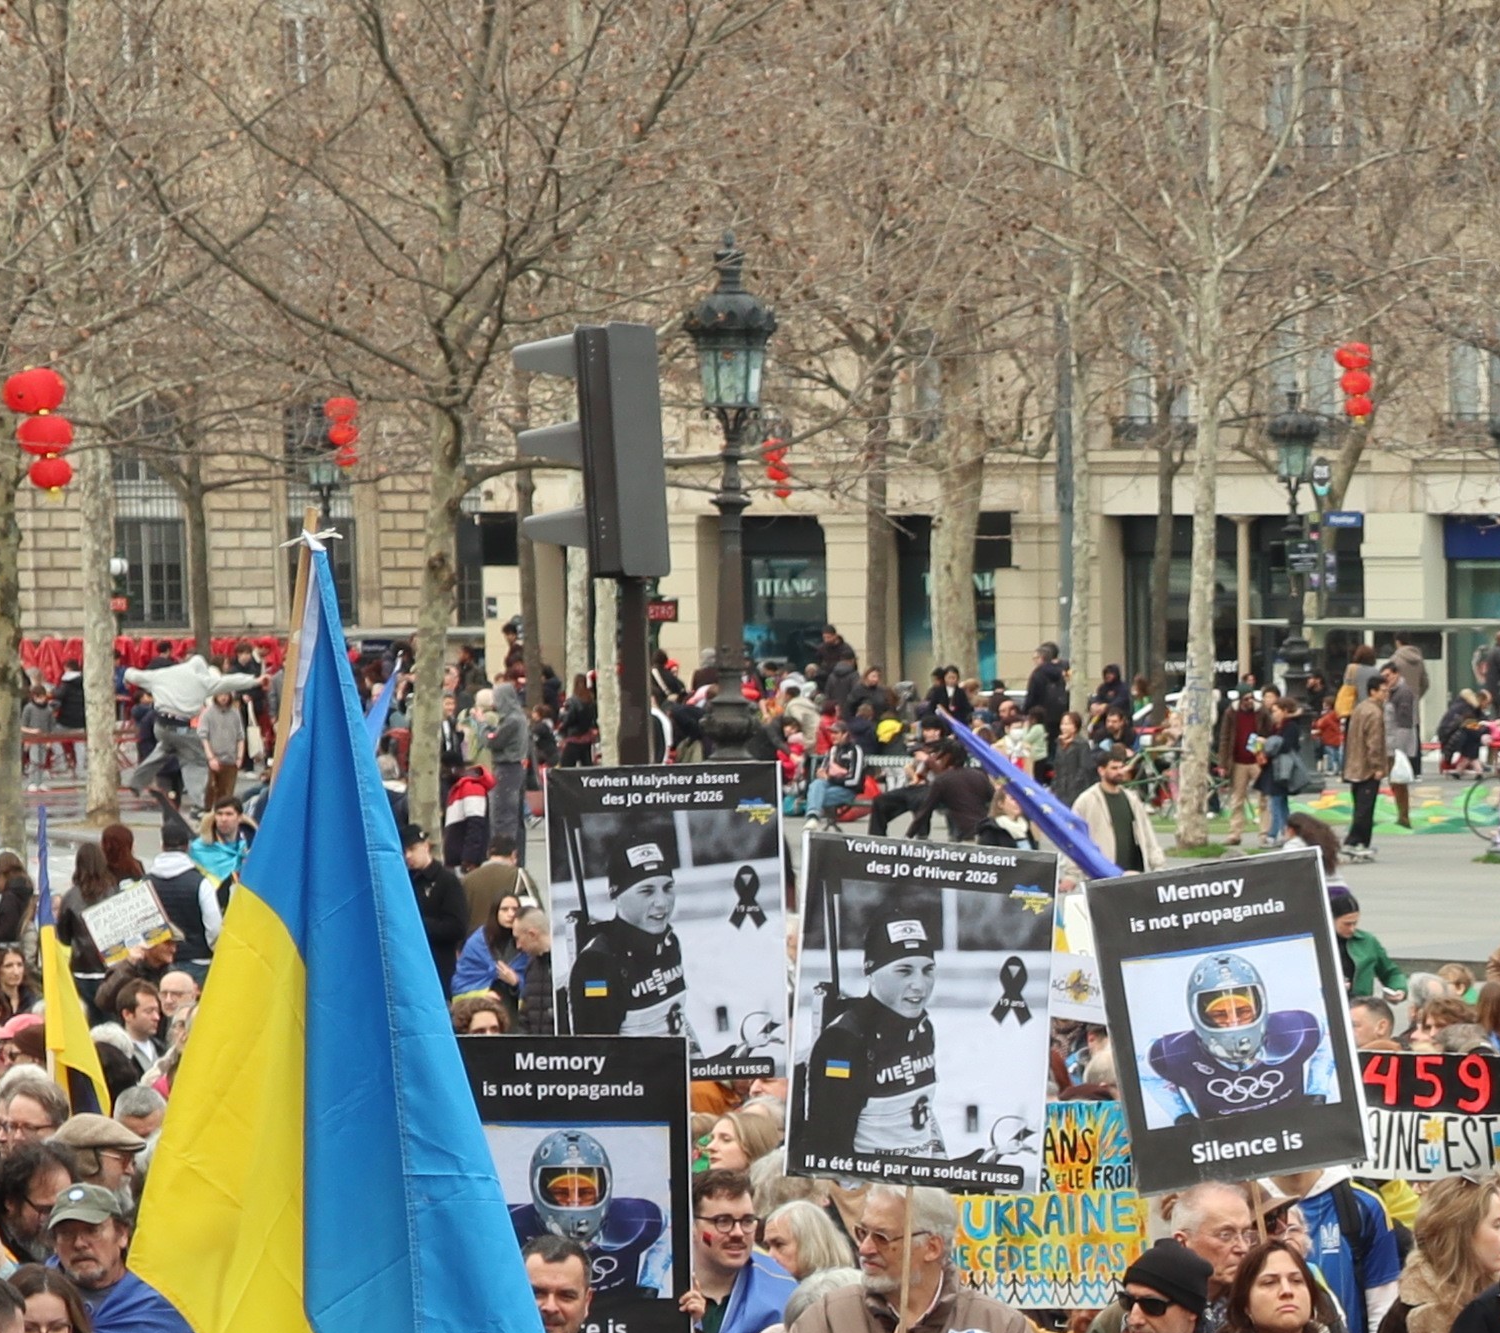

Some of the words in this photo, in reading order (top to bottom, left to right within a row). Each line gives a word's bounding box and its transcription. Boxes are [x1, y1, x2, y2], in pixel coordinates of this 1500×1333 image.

[756, 578, 820, 598] TITANIC
[580, 774, 629, 789] Yevhen
[631, 773, 693, 789] Malyshev
[695, 771, 740, 785] absent
[601, 793, 625, 807] des
[626, 792, 643, 808] JO
[693, 789, 724, 803] 2026
[845, 839, 898, 857] Yevhen
[900, 844, 967, 866] Malyshev
[969, 850, 1018, 867] absent
[866, 859, 891, 876] des
[892, 863, 911, 879] JO
[965, 870, 999, 886] 2026
[1156, 877, 1245, 903] Memory
[1130, 916, 1145, 933] is
[1148, 911, 1180, 931] not
[1182, 898, 1286, 929] propaganda
[514, 1051, 606, 1076] Memory
[691, 1062, 732, 1077] soldat
[735, 1063, 771, 1076] russe
[481, 1081, 497, 1097] is
[501, 1081, 532, 1097] not
[536, 1081, 645, 1101] propaganda
[1191, 1132, 1278, 1164] Silence
[1281, 1130, 1304, 1152] is
[1445, 1114, 1498, 1172] EST
[805, 1154, 815, 1169] Il
[817, 1159, 828, 1170] a
[829, 1156, 854, 1172] été
[856, 1158, 881, 1174] tué
[883, 1162, 909, 1179] par
[911, 1165, 931, 1178] un
[933, 1164, 978, 1183] soldat
[981, 1170, 1020, 1185] russe
[1068, 1168, 1085, 1190] LE
[962, 1190, 1137, 1241] UKRAINE
[977, 1239, 1071, 1274] CÉDERA
[1079, 1243, 1127, 1272] PAS
